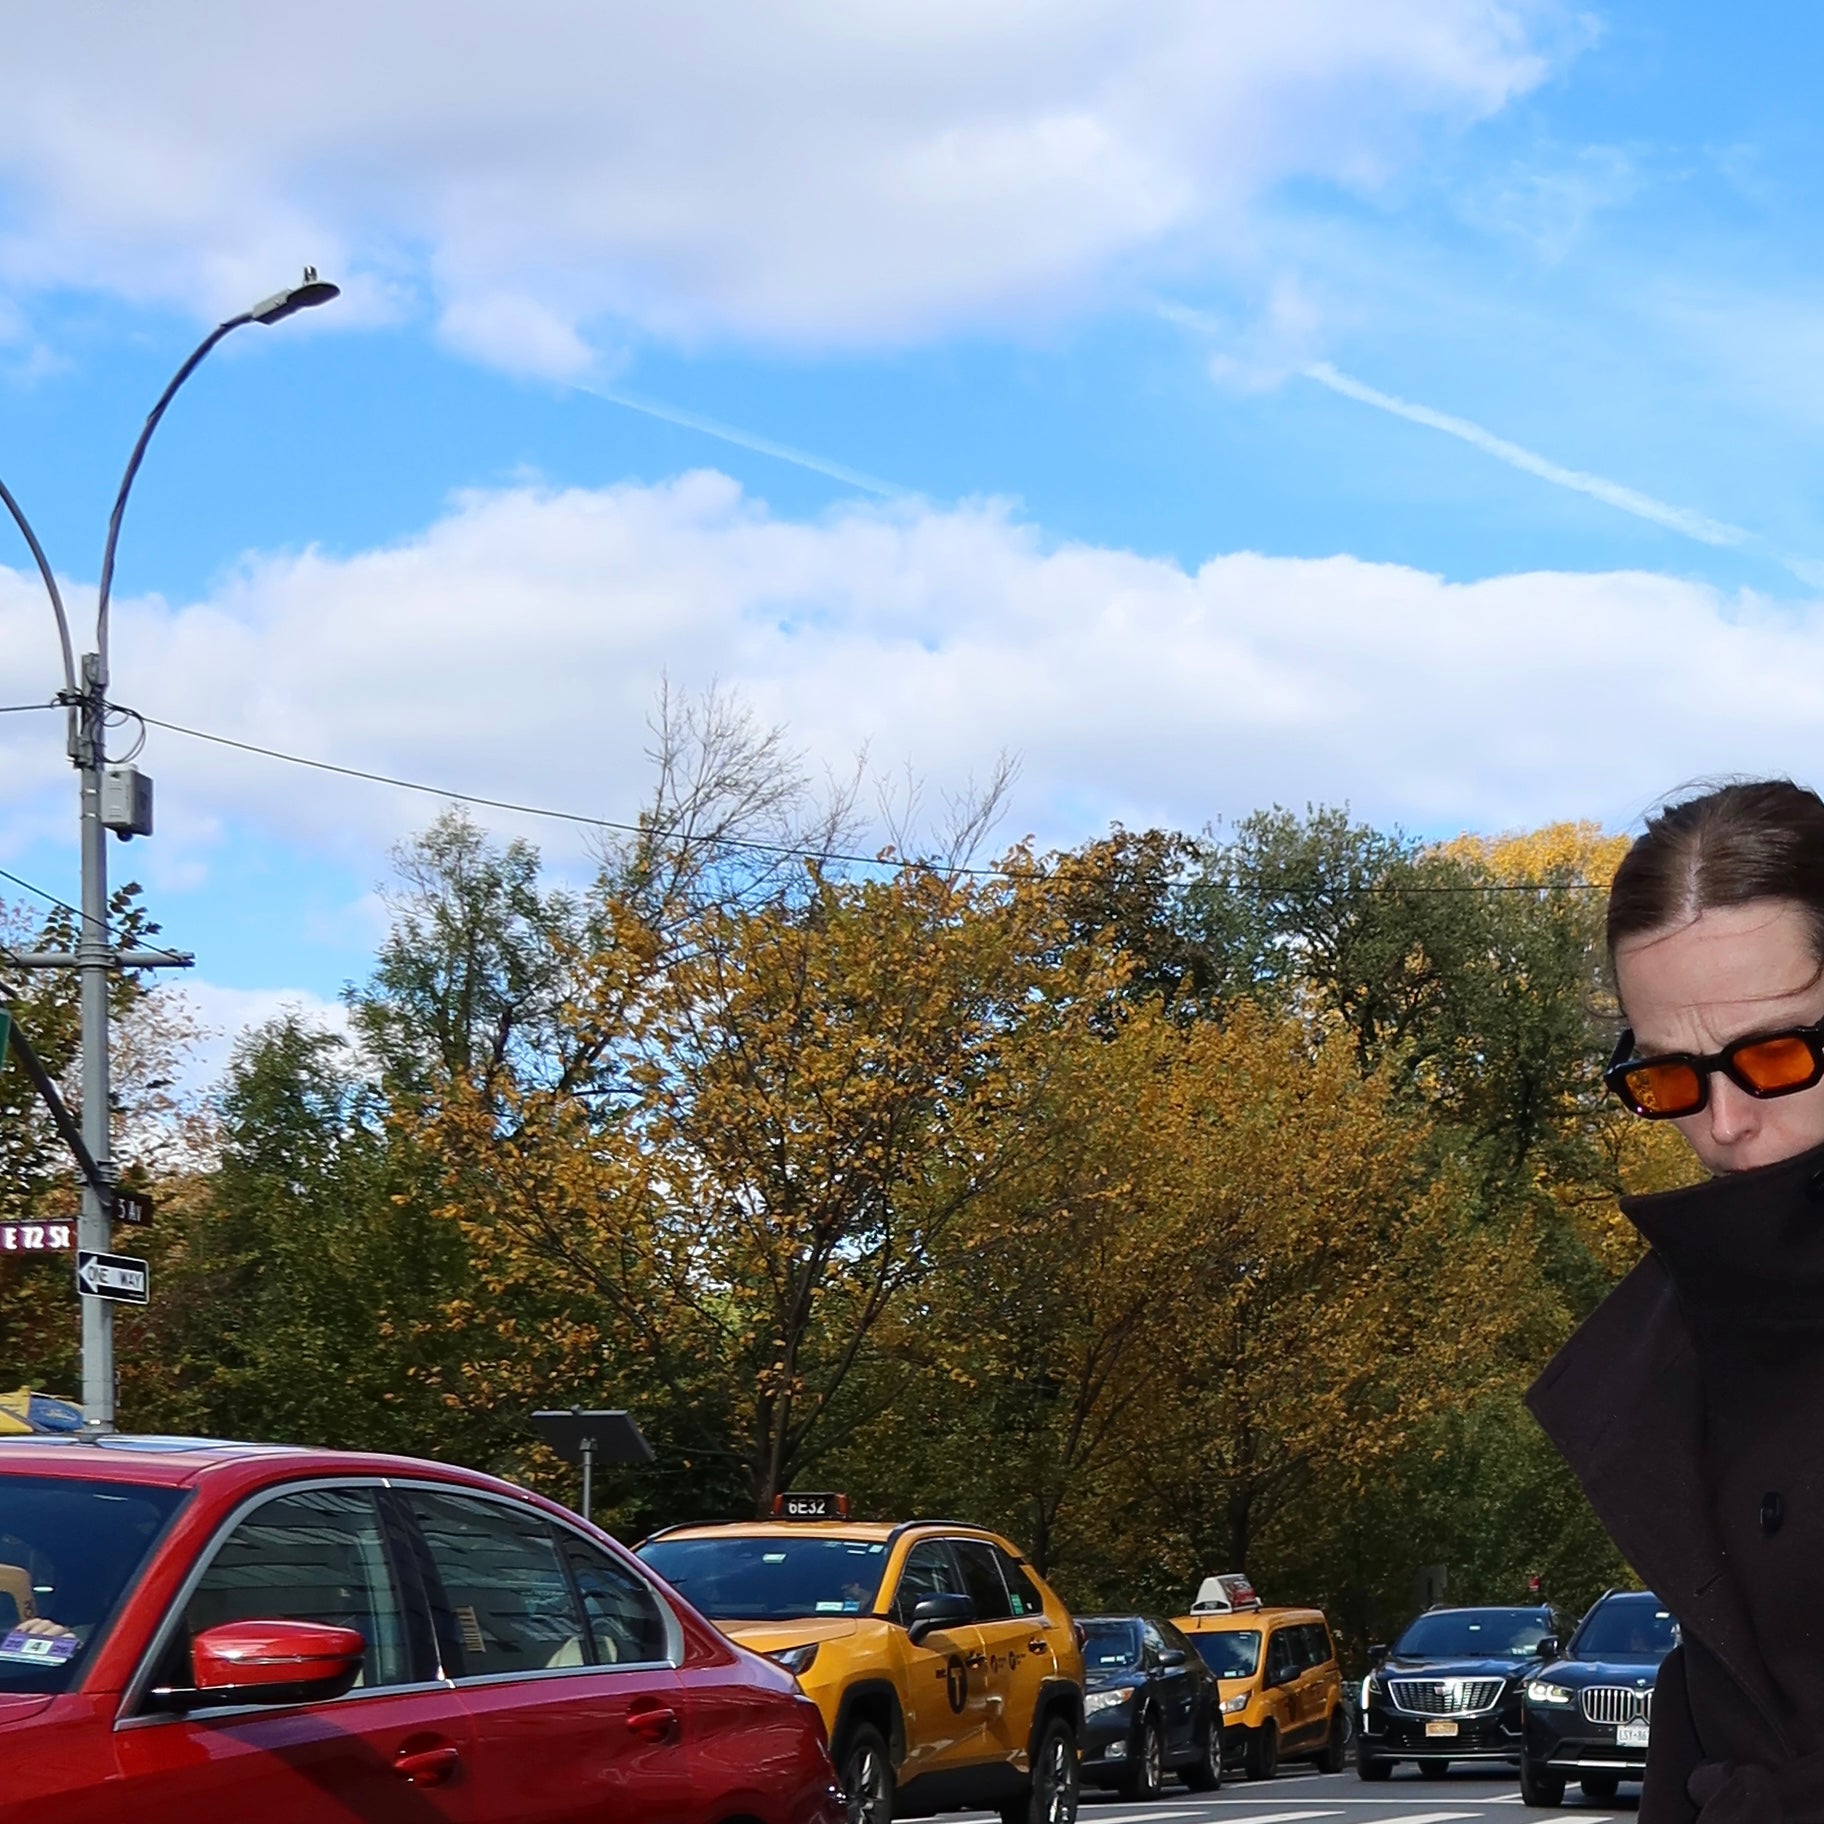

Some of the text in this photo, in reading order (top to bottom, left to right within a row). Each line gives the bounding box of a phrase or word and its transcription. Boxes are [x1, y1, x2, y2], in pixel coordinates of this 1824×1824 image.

[4, 1225, 70, 1249] E 72 St
[88, 1265, 144, 1288] ONE WAY
[788, 1499, 826, 1514] 6E32
